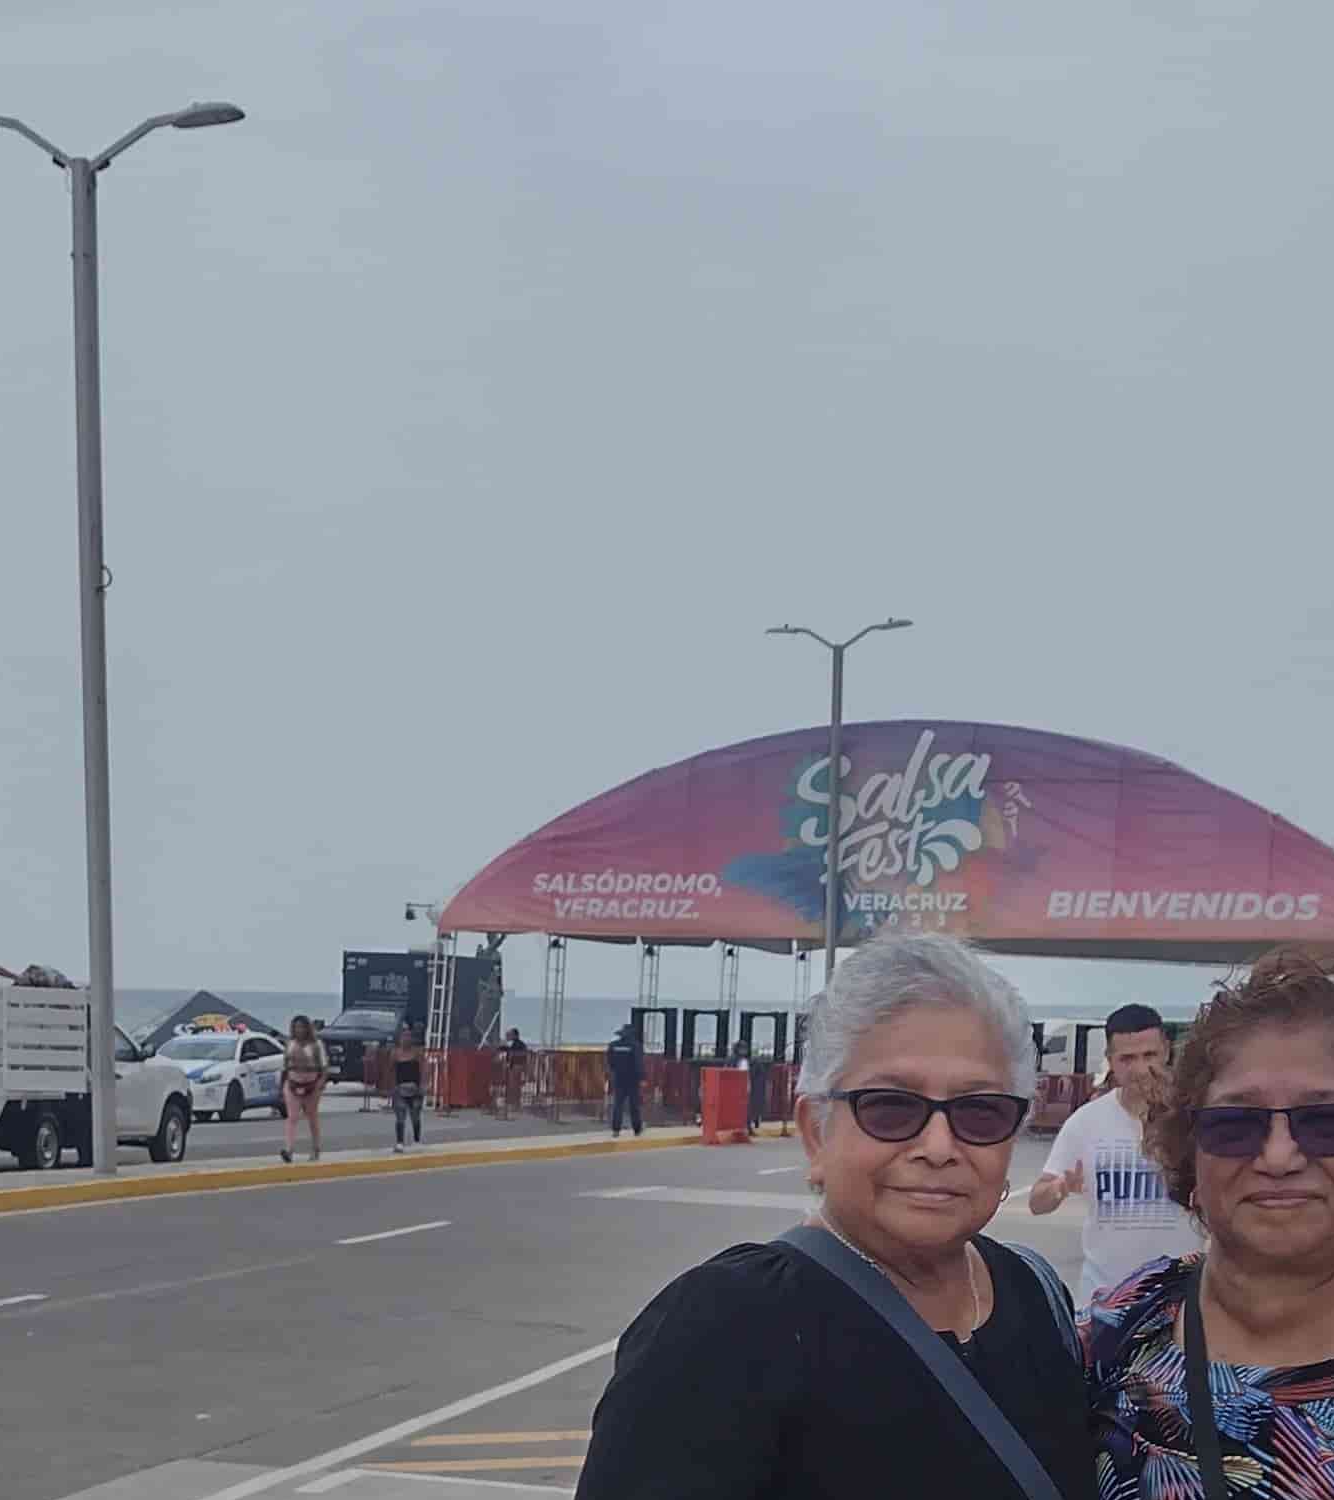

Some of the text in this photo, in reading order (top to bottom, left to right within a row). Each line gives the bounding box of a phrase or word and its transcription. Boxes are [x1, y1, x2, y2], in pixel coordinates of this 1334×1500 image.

[796, 729, 993, 846] Salsa
[819, 812, 935, 884] Fest
[532, 869, 723, 898] SALSÓDROMO,
[553, 897, 701, 920] VERACRUZ.
[843, 892, 968, 912] VERACRUZ
[1046, 889, 1323, 922] BIENVENIDOS
